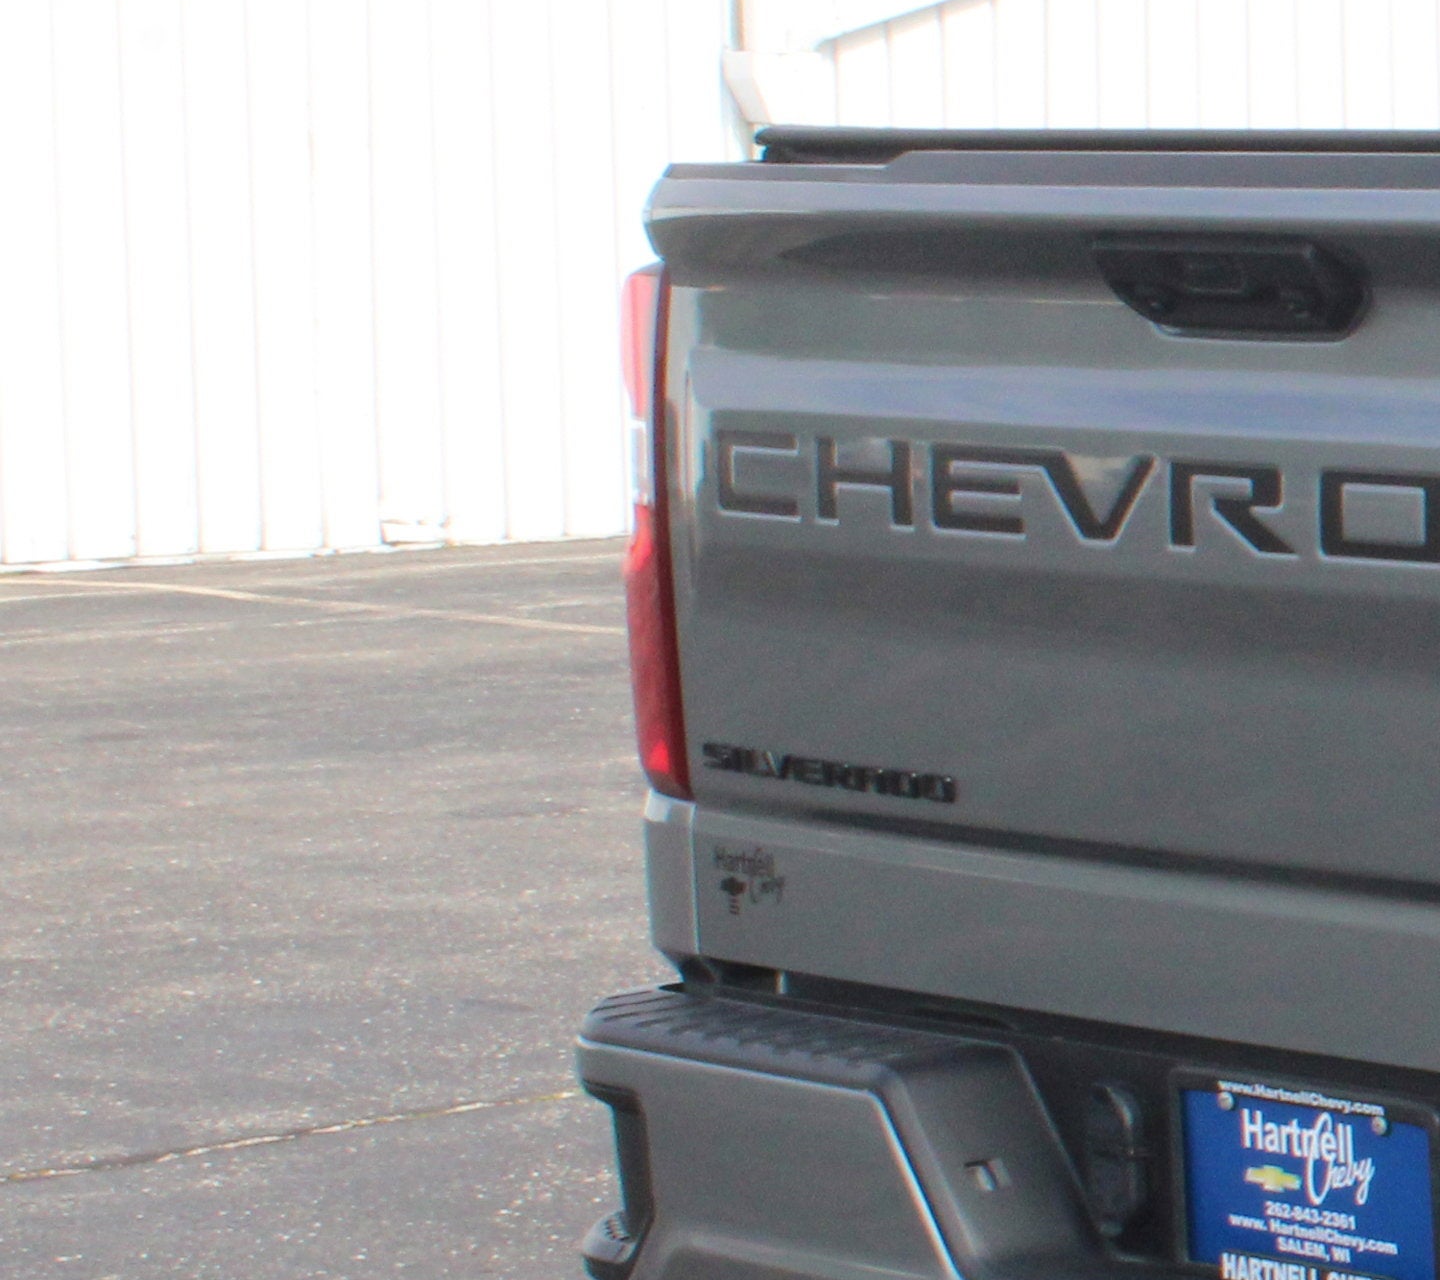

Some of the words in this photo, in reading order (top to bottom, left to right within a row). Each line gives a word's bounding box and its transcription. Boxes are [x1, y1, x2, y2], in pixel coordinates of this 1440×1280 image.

[1240, 1107, 1354, 1163] Hartnell
[1306, 1111, 1376, 1206] Chevy
[1276, 1236, 1330, 1263] SALEM,
[1330, 1246, 1351, 1263] WI
